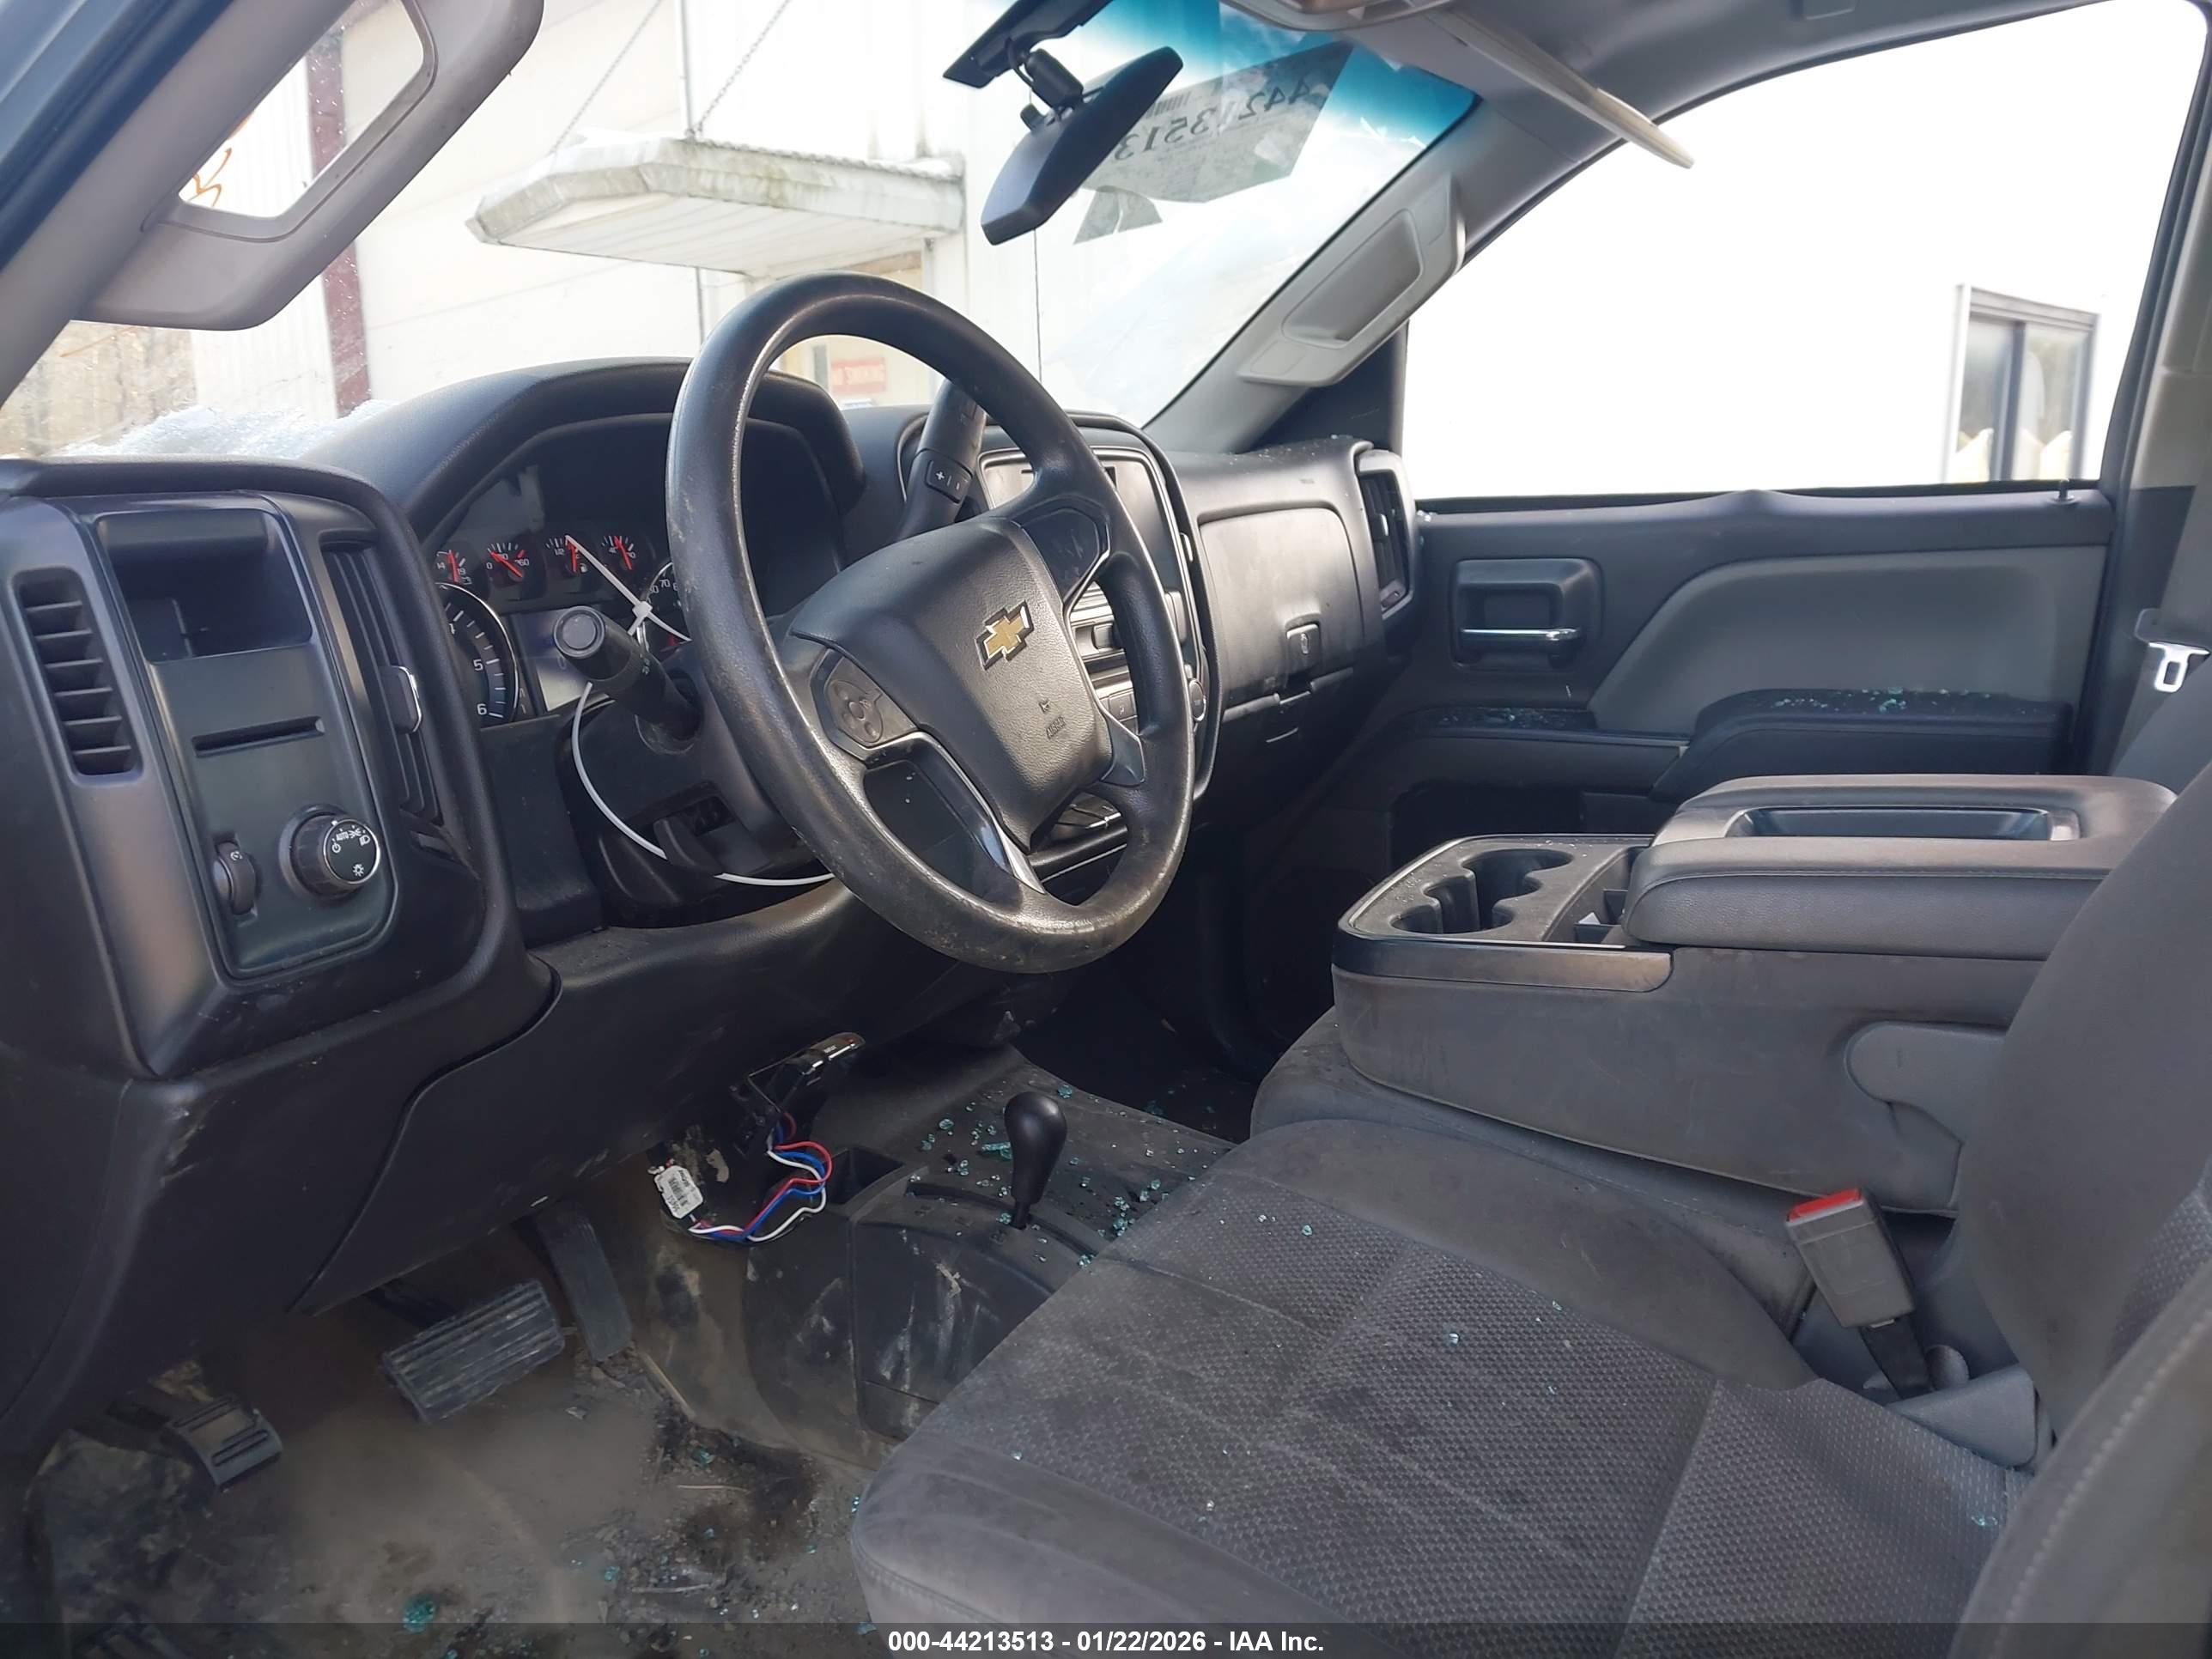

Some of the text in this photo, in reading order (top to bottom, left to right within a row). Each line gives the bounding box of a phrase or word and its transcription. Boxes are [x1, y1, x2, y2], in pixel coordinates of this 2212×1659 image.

[659, 579, 671, 588] 70
[473, 659, 483, 672] 5
[477, 703, 488, 715] 6
